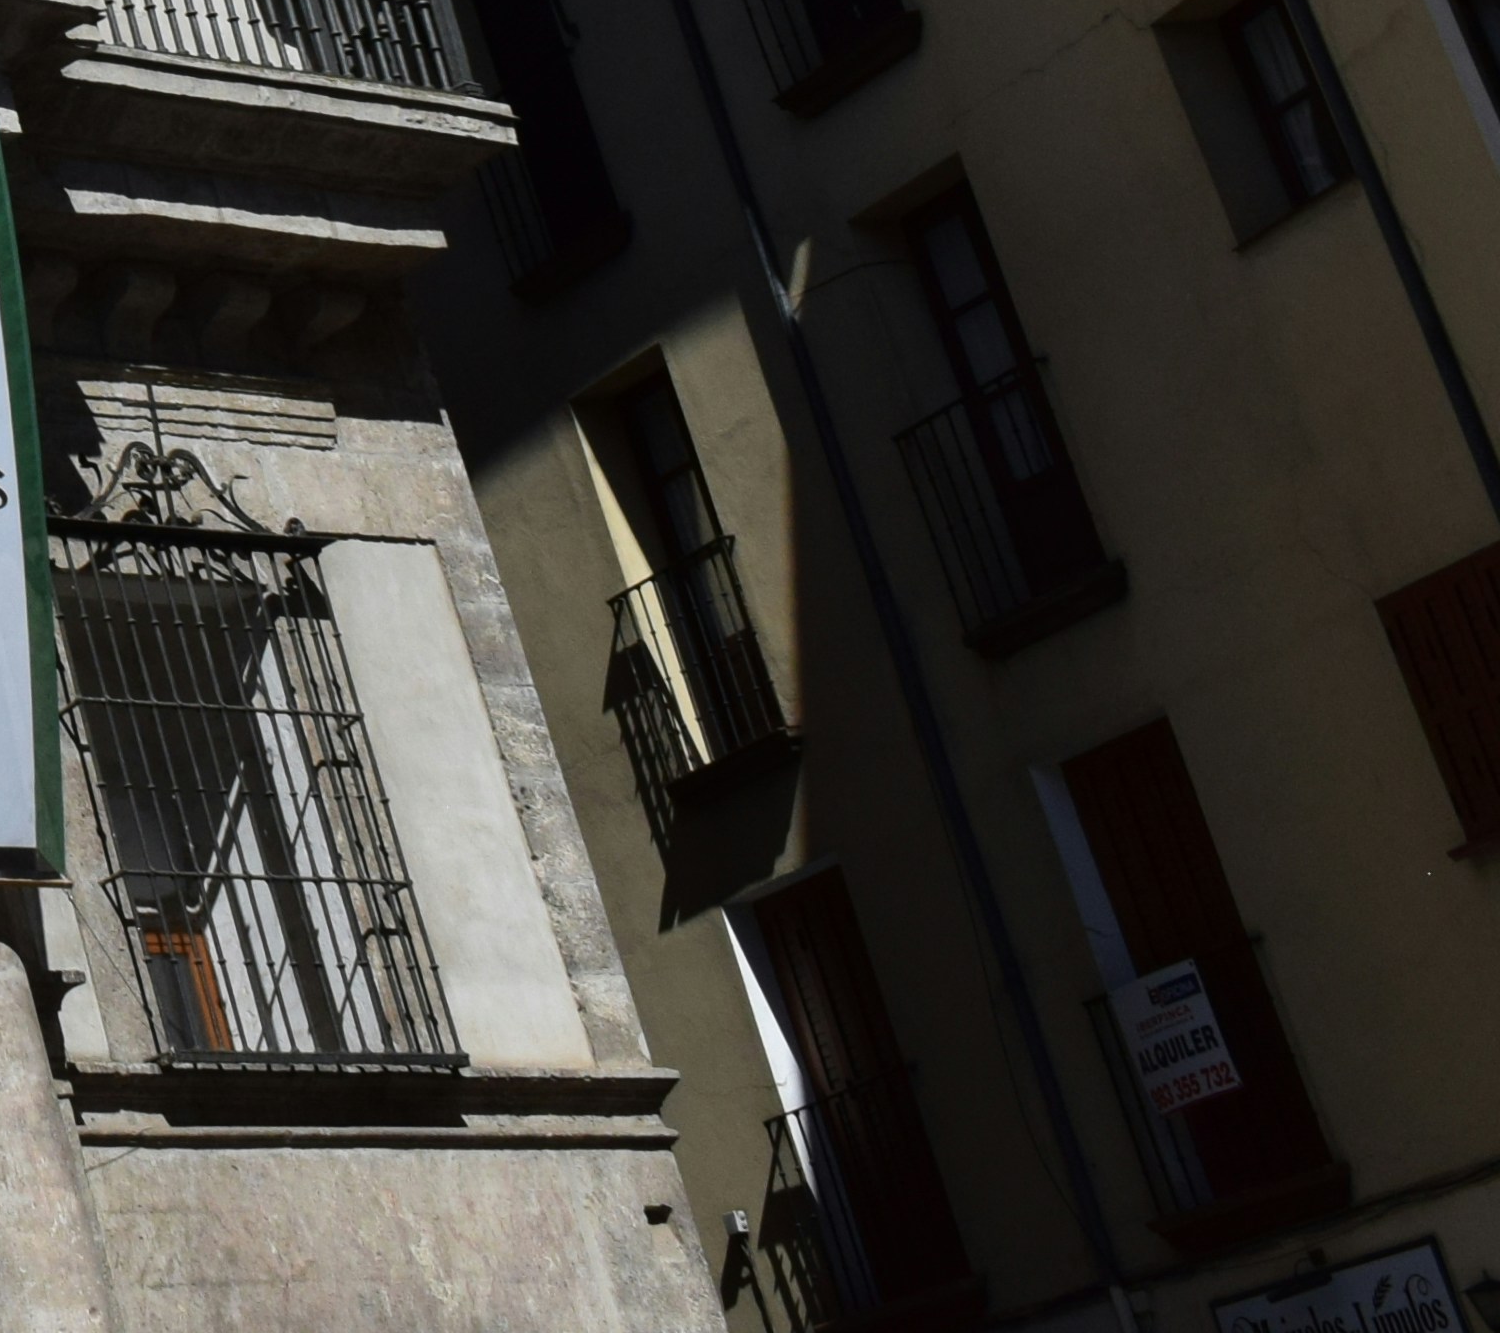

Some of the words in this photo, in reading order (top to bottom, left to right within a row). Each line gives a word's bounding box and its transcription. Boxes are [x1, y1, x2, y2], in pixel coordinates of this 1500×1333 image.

[1138, 1024, 1219, 1075] ALQUILER
[1173, 1072, 1201, 1101] 355
[1200, 1061, 1235, 1090] 732
